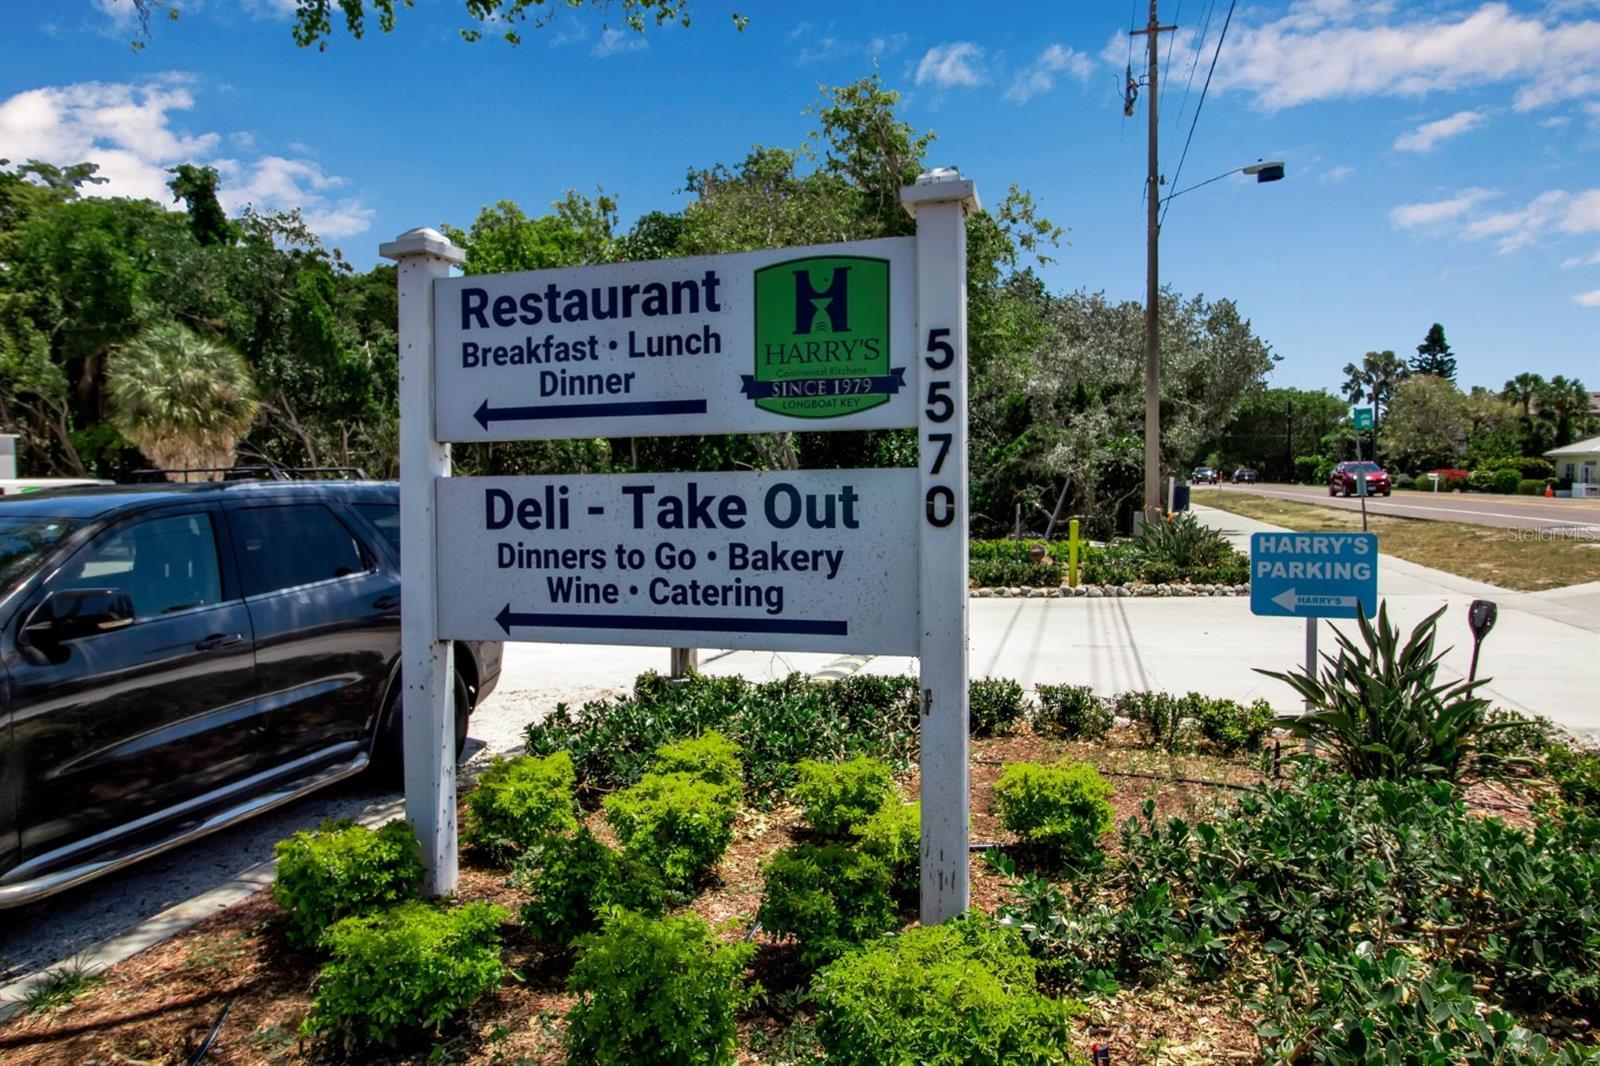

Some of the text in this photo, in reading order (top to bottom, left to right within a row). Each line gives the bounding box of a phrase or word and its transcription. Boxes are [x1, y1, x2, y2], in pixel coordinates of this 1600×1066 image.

[460, 270, 721, 330] Restaurant
[461, 325, 722, 368] Breakfast Lunch
[764, 338, 880, 365] HARRY'S
[539, 368, 635, 397] Dinner
[776, 366, 868, 378] Continental Kitchens
[771, 378, 872, 397] SINCE 1979
[782, 398, 860, 410] LONGBOAT KEY
[925, 328, 955, 528] 5570
[485, 485, 570, 530] Deli
[622, 482, 747, 530] Take
[764, 482, 860, 530] Out
[1259, 536, 1369, 555] HARRY'S
[497, 541, 844, 580] Dinners to Go Bakery
[1257, 561, 1371, 580] PARKING
[547, 576, 785, 615] Wine Catering
[1297, 597, 1342, 605] HARRY'S
